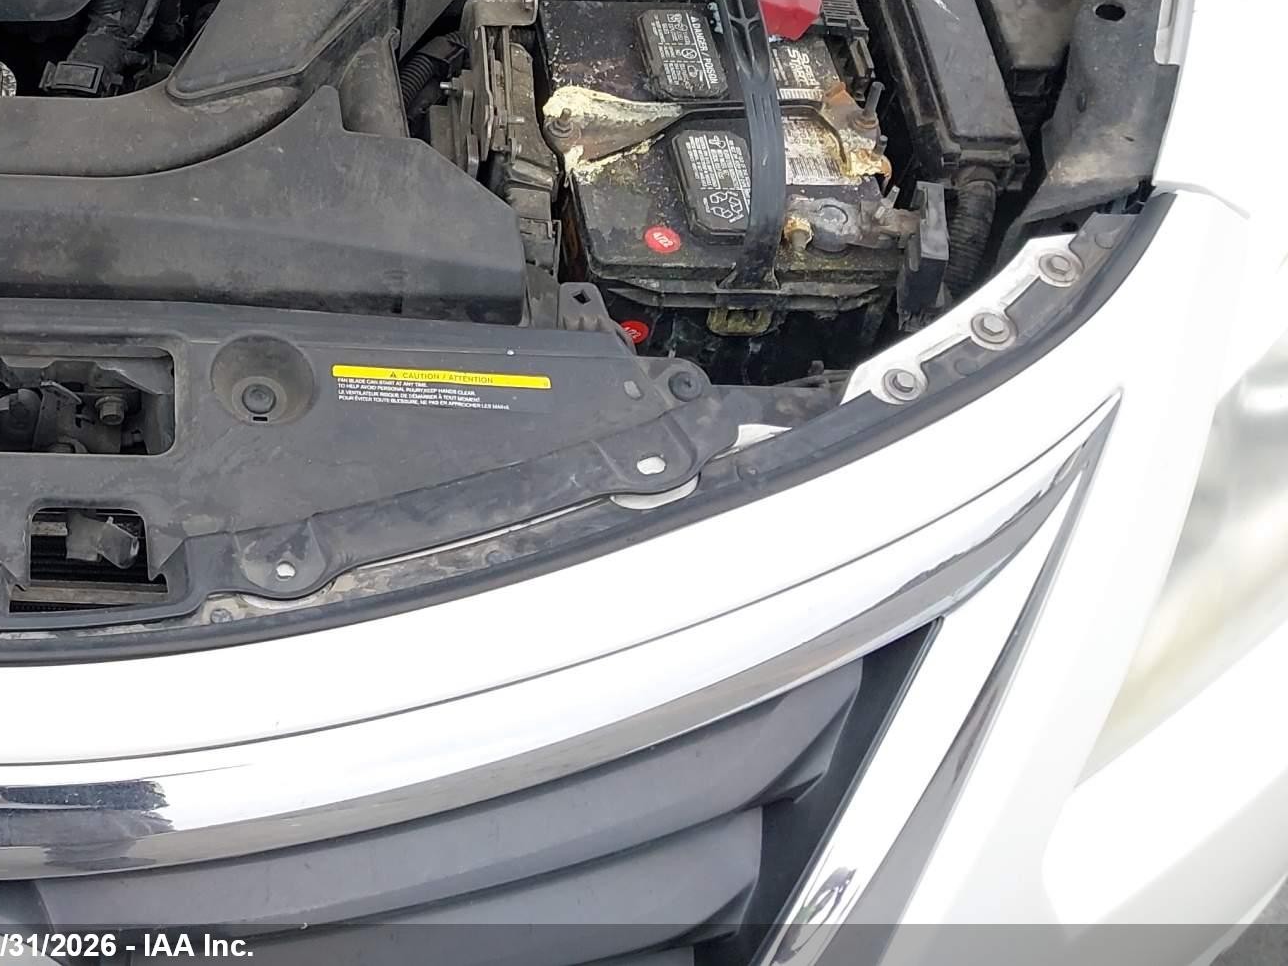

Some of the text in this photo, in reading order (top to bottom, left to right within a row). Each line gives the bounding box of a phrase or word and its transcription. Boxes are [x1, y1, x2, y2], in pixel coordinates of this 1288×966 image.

[692, 22, 709, 52] DANGER
[702, 57, 719, 85] POISON
[402, 371, 440, 380] CAUTION
[448, 375, 494, 384] ATTENTION
